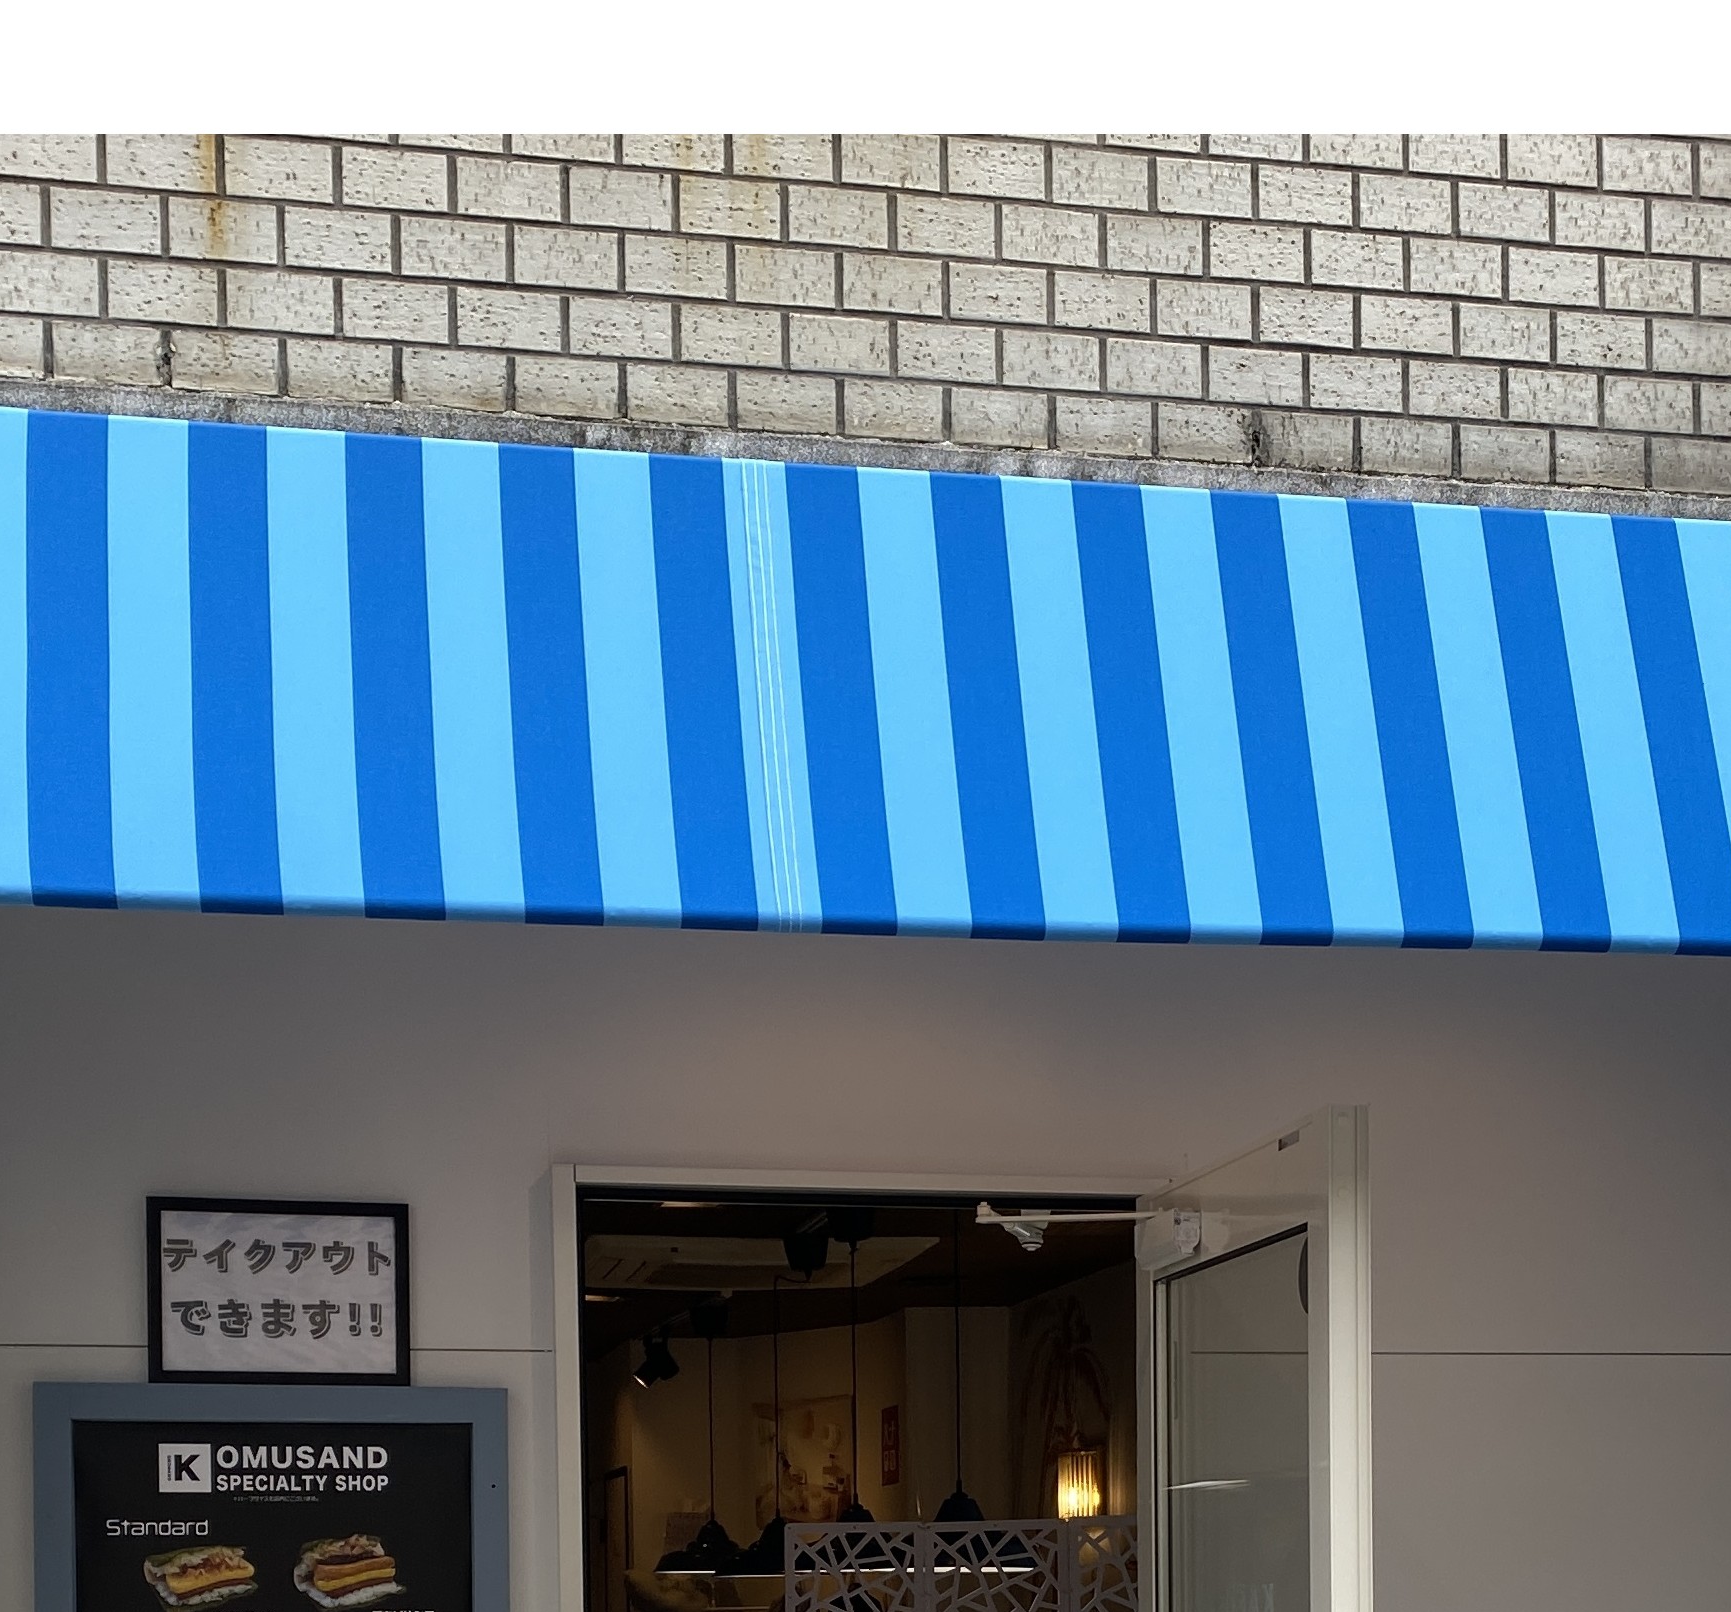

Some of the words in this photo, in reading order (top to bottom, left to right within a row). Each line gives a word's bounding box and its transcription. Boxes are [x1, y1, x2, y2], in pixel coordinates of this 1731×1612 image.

[163, 1238, 391, 1276] テイクアウト
[170, 1298, 383, 1339] できます!!
[174, 1454, 200, 1481] K
[217, 1445, 388, 1469] OMUSAND
[216, 1475, 328, 1491] SPECIALTY
[335, 1475, 389, 1491] SHOP
[106, 1518, 209, 1537] Standard
